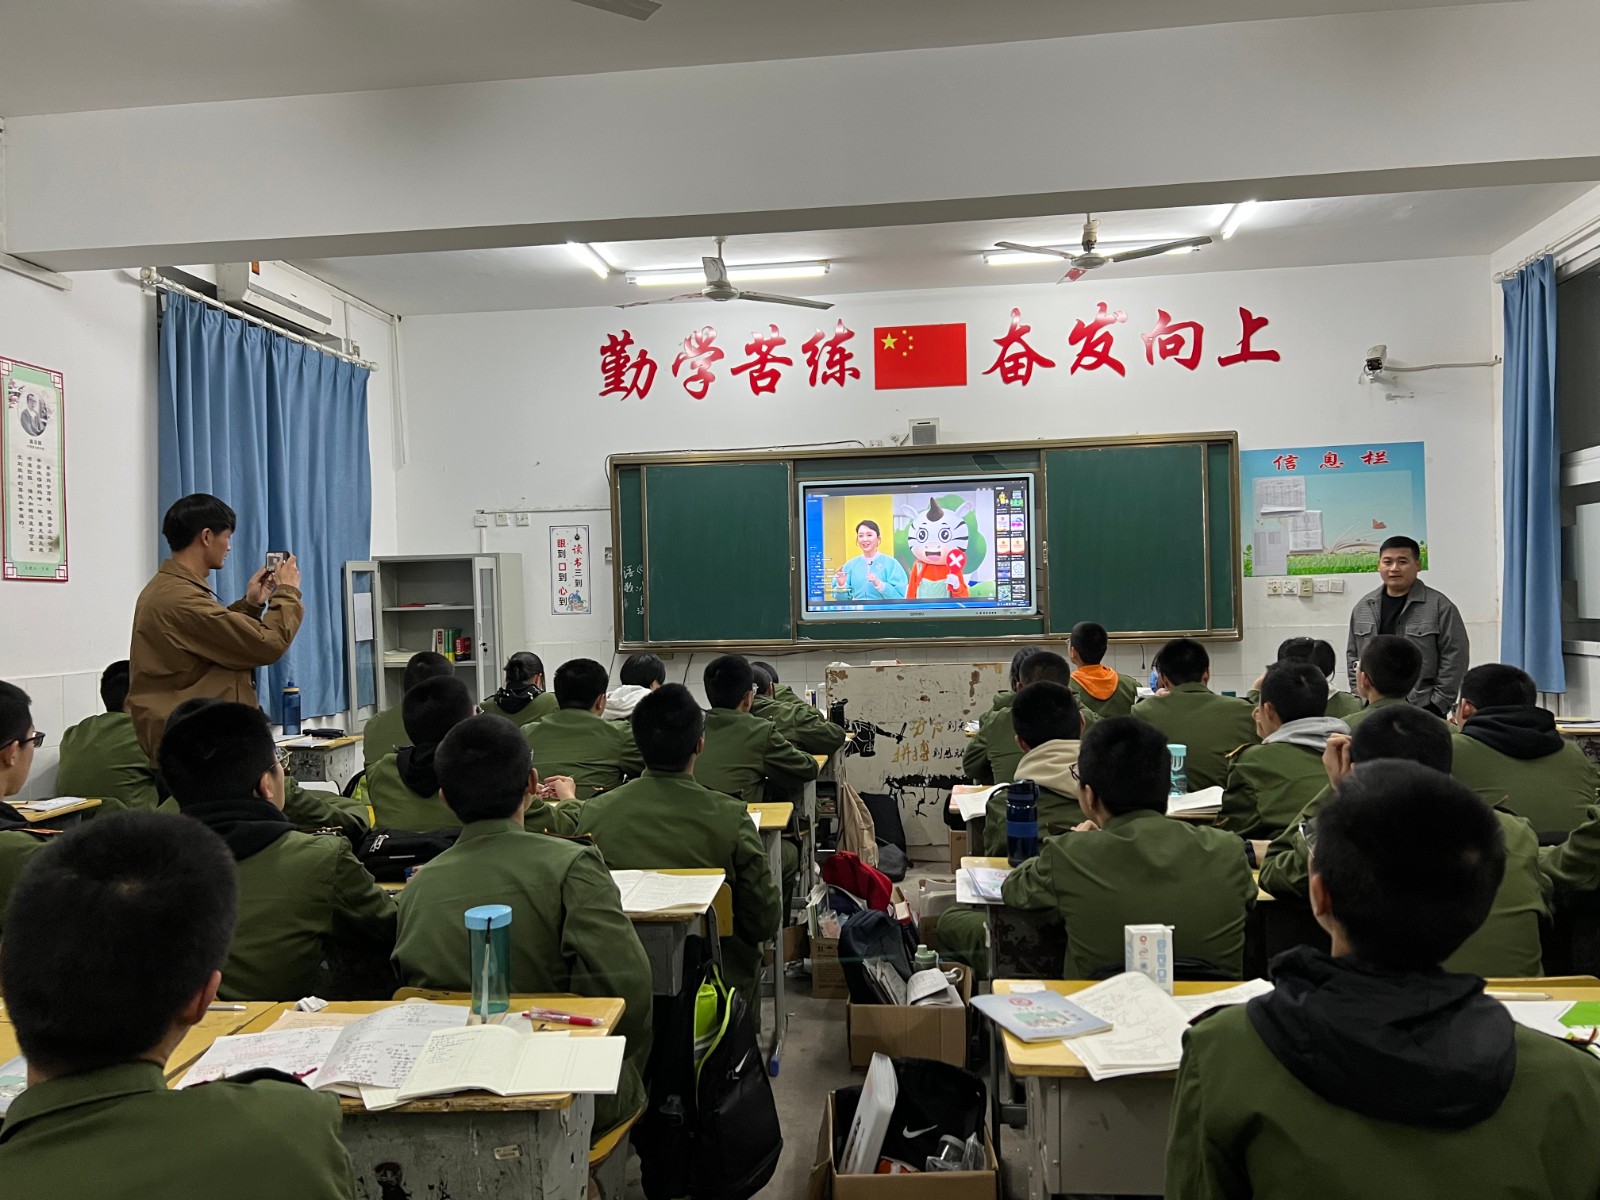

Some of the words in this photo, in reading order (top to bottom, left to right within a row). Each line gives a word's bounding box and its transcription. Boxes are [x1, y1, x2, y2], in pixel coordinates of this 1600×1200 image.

[599, 318, 862, 401] 勤学苦练
[981, 302, 1282, 387] 奋发向上
[1272, 450, 1391, 471] 信息栏
[557, 539, 568, 606] 眼到口到心到
[572, 544, 583, 588] 读书三到
